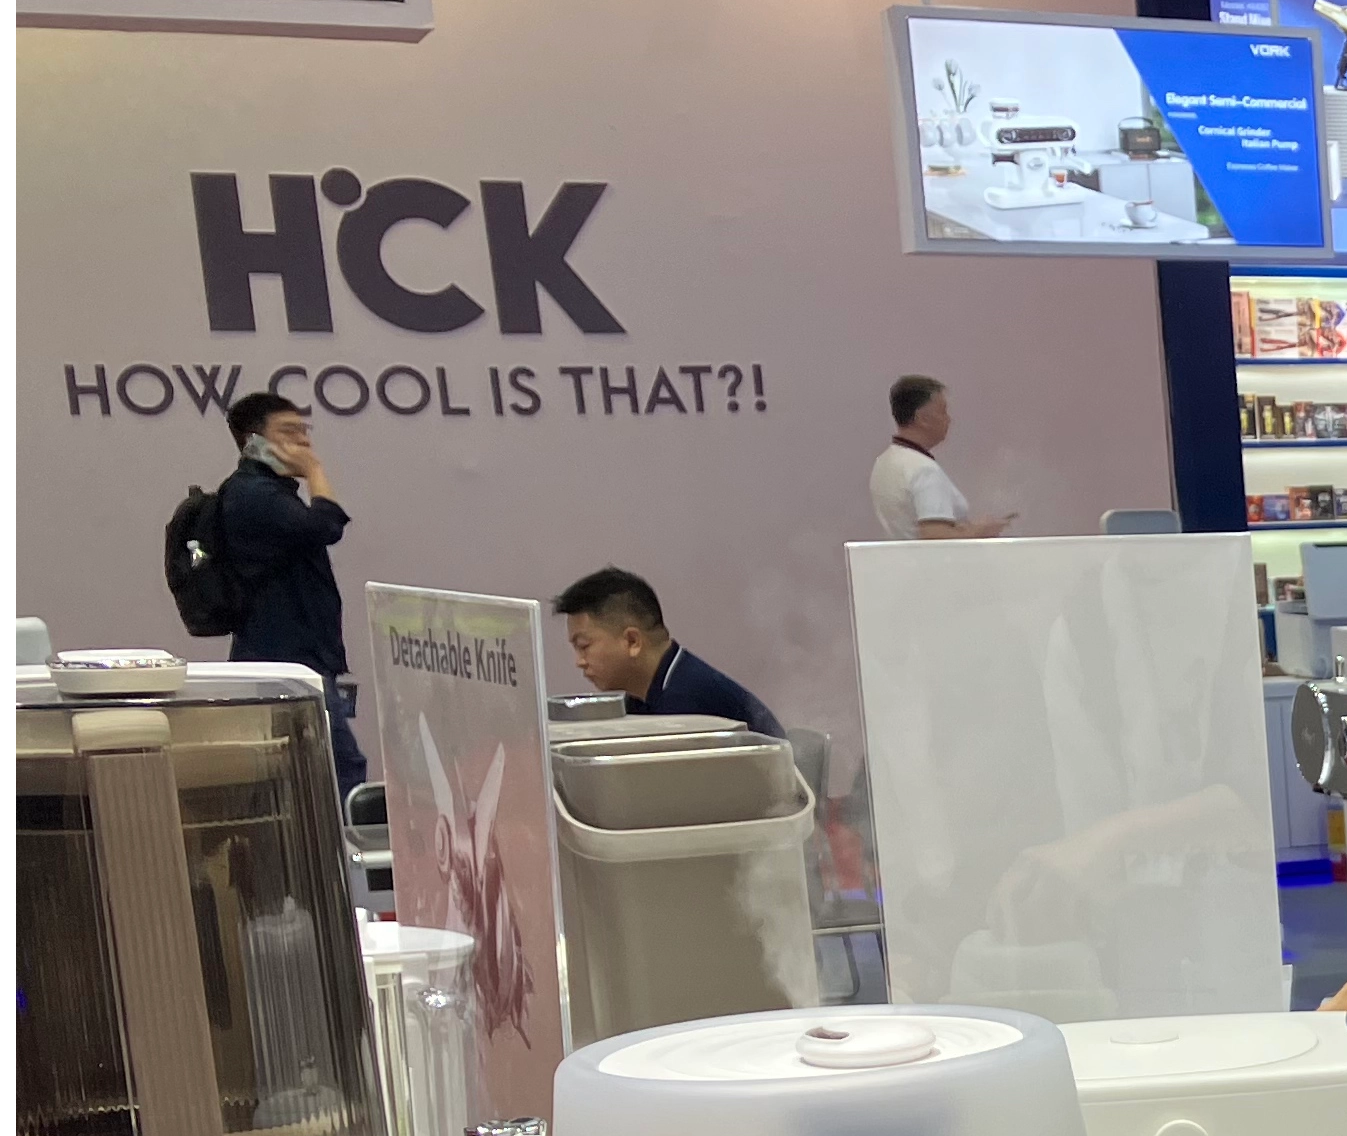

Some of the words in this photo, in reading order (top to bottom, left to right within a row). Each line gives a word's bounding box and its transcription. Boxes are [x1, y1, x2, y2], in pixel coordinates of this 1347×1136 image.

[1250, 44, 1291, 58] VORK
[1165, 91, 1207, 108] Elegant
[1209, 94, 1307, 110] Semi-Commercial
[1272, 139, 1299, 151] Pump
[64, 363, 242, 417] HOW
[268, 364, 470, 417] COOL
[488, 366, 541, 417] IS
[558, 363, 767, 416] THAT?!
[389, 625, 472, 680] Detachable
[474, 637, 518, 687] Knife
